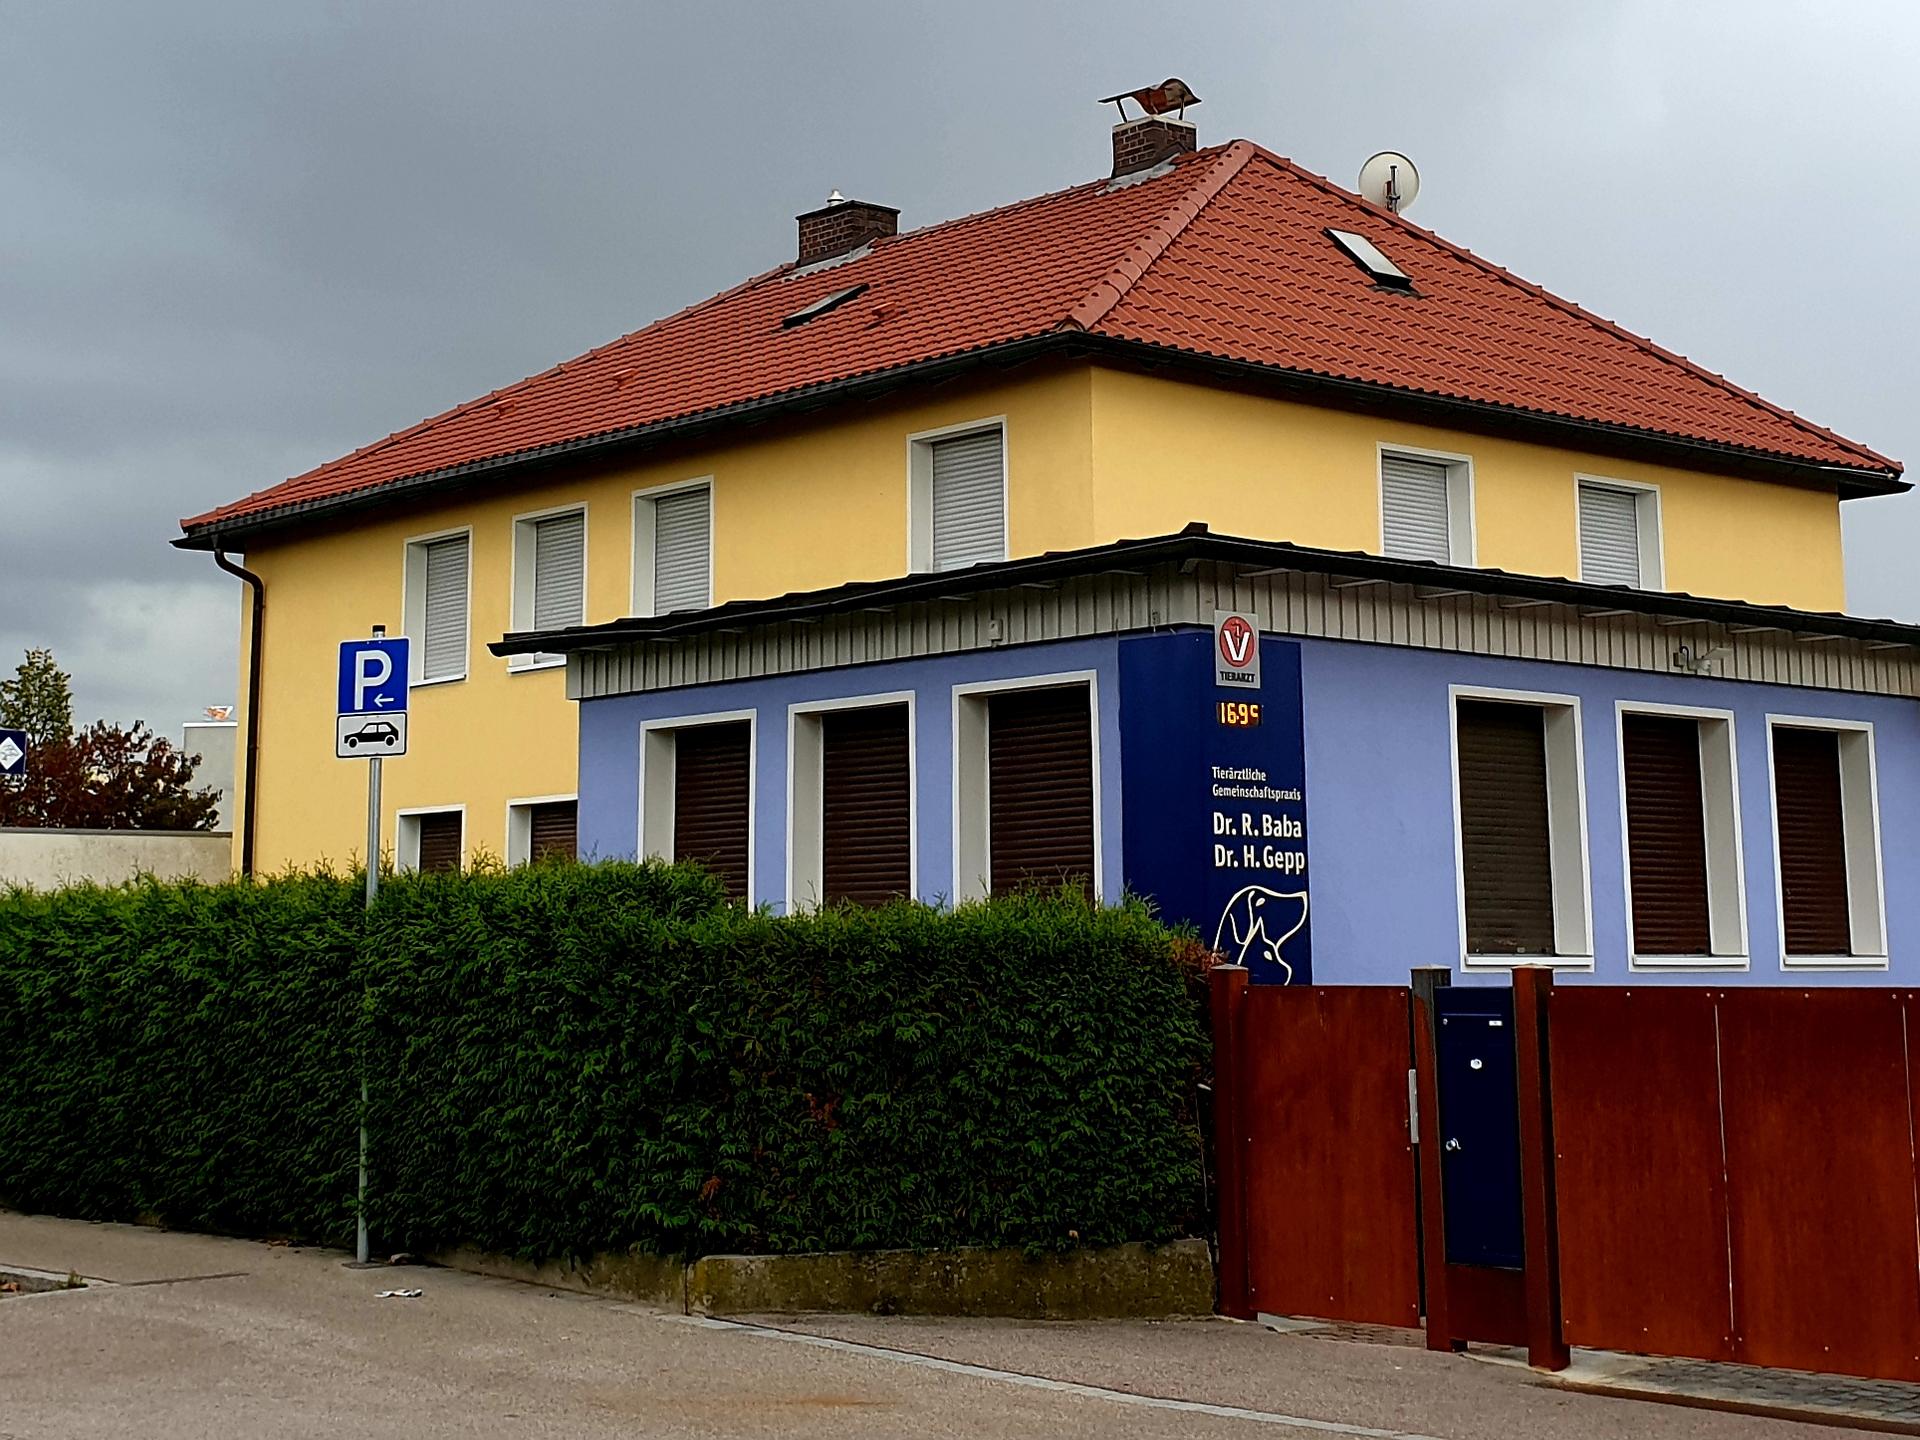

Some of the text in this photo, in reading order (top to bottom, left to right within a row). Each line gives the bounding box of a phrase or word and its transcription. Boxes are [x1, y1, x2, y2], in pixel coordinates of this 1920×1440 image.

[354, 650, 393, 710] P
[1220, 671, 1256, 683] TIERARZT
[1212, 766, 1267, 781] Tierärztliche
[1212, 784, 1302, 802] Gemeinschaftspraxis
[1213, 812, 1303, 838] Dr. R. Baba
[1214, 844, 1305, 875] Dr. H. Gepp
